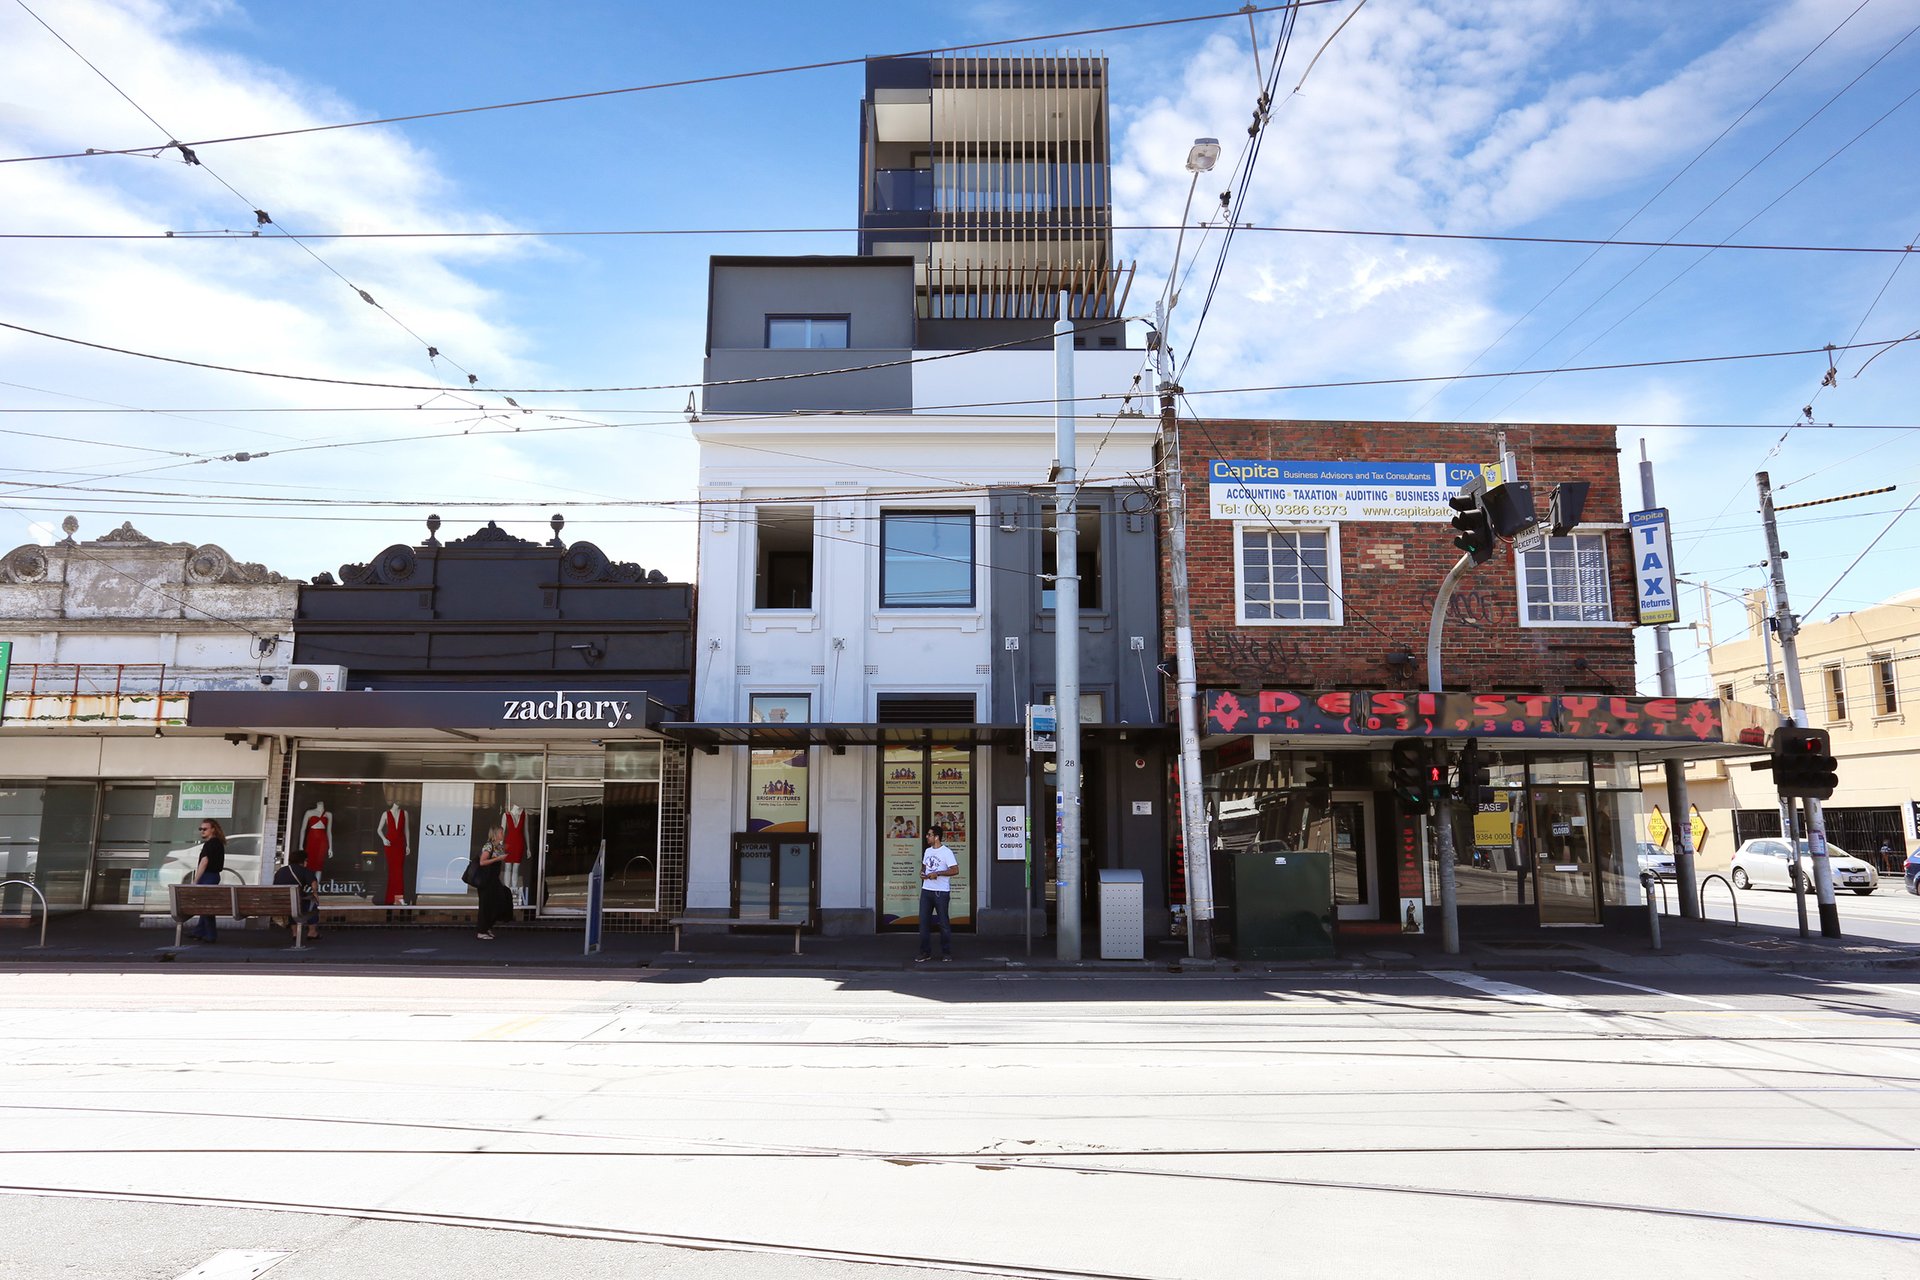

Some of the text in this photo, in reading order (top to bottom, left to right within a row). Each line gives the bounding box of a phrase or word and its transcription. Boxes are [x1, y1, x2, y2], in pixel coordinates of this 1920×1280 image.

[1213, 462, 1431, 481] Capita Business Advisors and Tax Consultants
[1450, 469, 1475, 480] CPA
[1226, 488, 1286, 500] ACCOUNTING
[1293, 489, 1338, 501] TAXATION
[1345, 490, 1388, 501] AUDITING
[1395, 491, 1440, 502] BUSINESS
[1217, 503, 1454, 518] Tel: (03) 9386 6373 www.capitabatc
[1633, 511, 1664, 522] Capita
[1640, 526, 1665, 596] TAX
[1641, 599, 1671, 609] Returns
[503, 691, 632, 728] zachary.
[1259, 691, 1677, 720] DESI STYLE
[1185, 737, 1195, 745] 28
[183, 785, 231, 793] FOR LEASE
[1479, 803, 1501, 811] EASE
[425, 824, 466, 837] SALE
